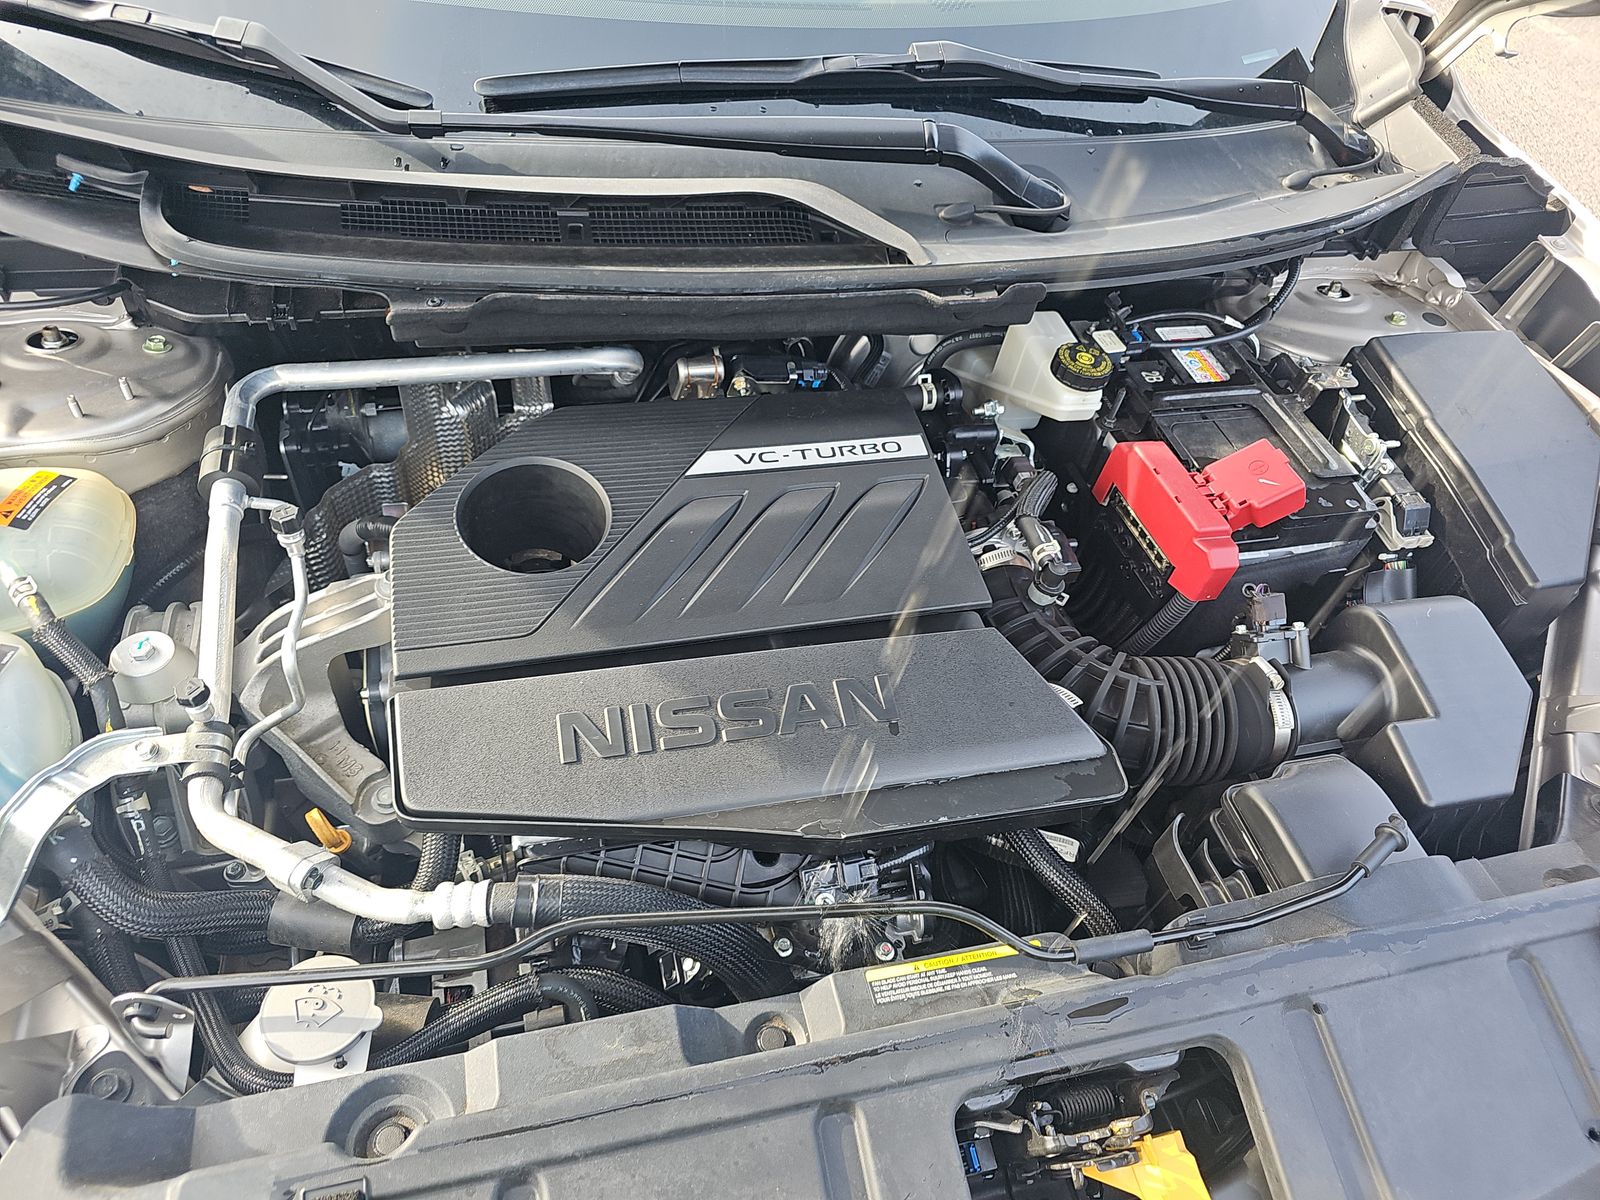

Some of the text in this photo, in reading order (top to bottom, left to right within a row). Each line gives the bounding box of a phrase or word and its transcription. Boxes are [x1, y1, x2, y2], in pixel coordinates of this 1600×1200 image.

[1140, 370, 1164, 383] 2B
[734, 441, 902, 465] VC-TURBO
[555, 674, 899, 765] NISSAN
[924, 958, 954, 969] CAUTION
[961, 951, 997, 961] ATTENTION
[907, 978, 929, 986] PERSONAL
